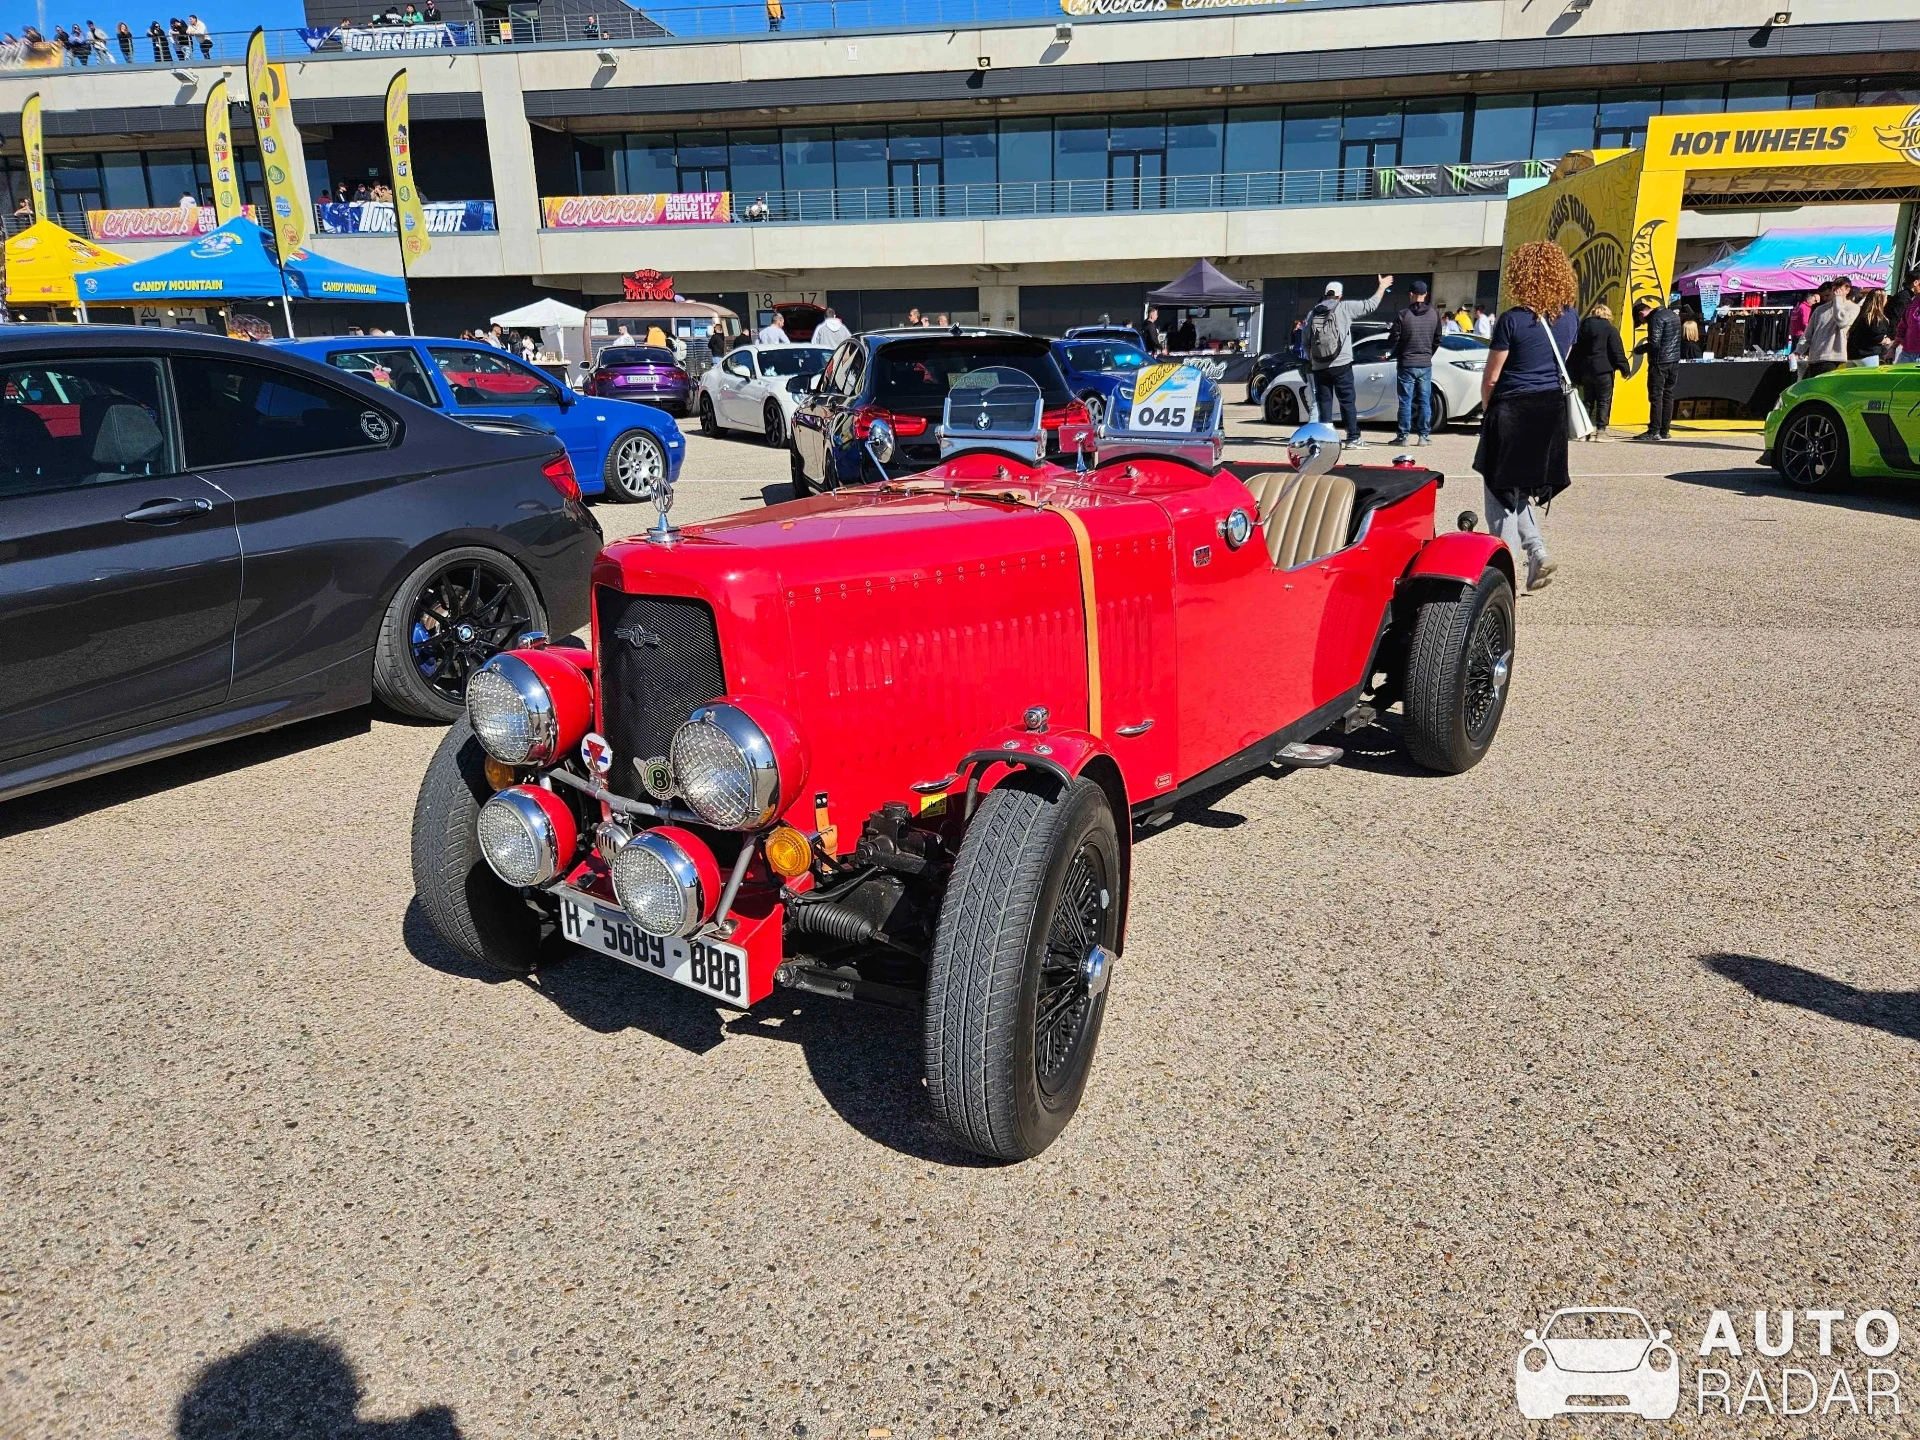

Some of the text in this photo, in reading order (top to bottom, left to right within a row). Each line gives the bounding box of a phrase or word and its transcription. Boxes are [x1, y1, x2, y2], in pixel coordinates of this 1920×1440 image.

[1670, 126, 1849, 156] HOT WHEELS
[1397, 172, 1437, 182] MONSTER
[1469, 168, 1511, 178] MONSTER
[666, 194, 720, 204] DREAM IT.
[666, 202, 714, 212] BUILD IT.
[666, 211, 715, 221] DRIVE IT.
[132, 280, 224, 292] CANDY MOUNTAIN
[322, 281, 377, 294] CANDY MOUNTAIN
[624, 288, 675, 300] TATTOO
[755, 293, 774, 308] 18
[140, 307, 157, 317] 20
[1138, 407, 1187, 427] 045
[603, 919, 666, 969] 5689
[690, 942, 742, 999] BBB
